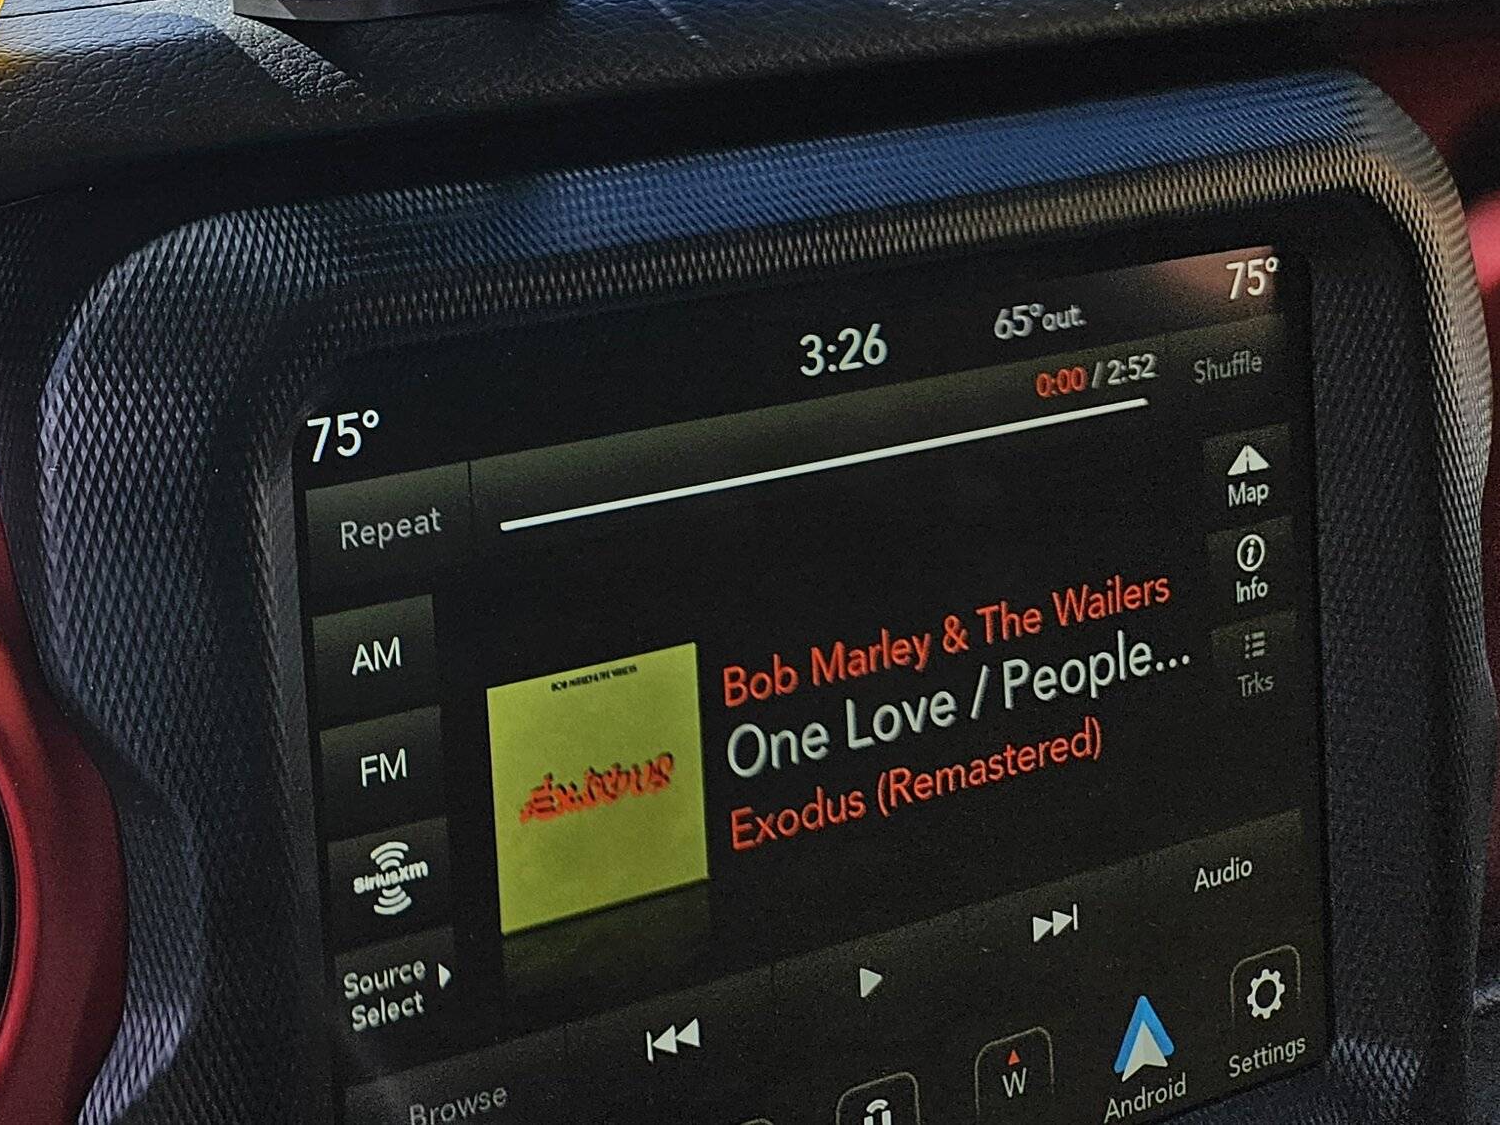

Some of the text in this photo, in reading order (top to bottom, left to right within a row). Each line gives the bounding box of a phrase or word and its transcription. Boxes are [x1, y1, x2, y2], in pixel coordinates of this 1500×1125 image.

[1226, 256, 1280, 300] 75°
[799, 324, 888, 376] 3:26
[1194, 350, 1263, 385] Shuffle
[1035, 366, 1088, 398] 0:00
[1107, 353, 1156, 385] 2:52
[306, 409, 380, 463] 75°
[1227, 482, 1269, 507] Map
[339, 507, 443, 551] Repeat
[1236, 576, 1269, 604] Info
[351, 637, 402, 676] AM
[723, 575, 1172, 708] Bob Marley & The Wailers
[727, 630, 1191, 778] One Love / People...
[1237, 671, 1275, 697] Trks
[360, 749, 408, 787] FM
[731, 716, 1103, 852] Exodus (Remastered)
[1193, 858, 1254, 893] Audio
[344, 958, 427, 1000] Source
[351, 990, 425, 1032] Select
[1228, 1037, 1307, 1079] Settings
[1002, 1066, 1027, 1098] W
[1104, 1073, 1188, 1125] Android
[409, 1085, 508, 1125] Browse
